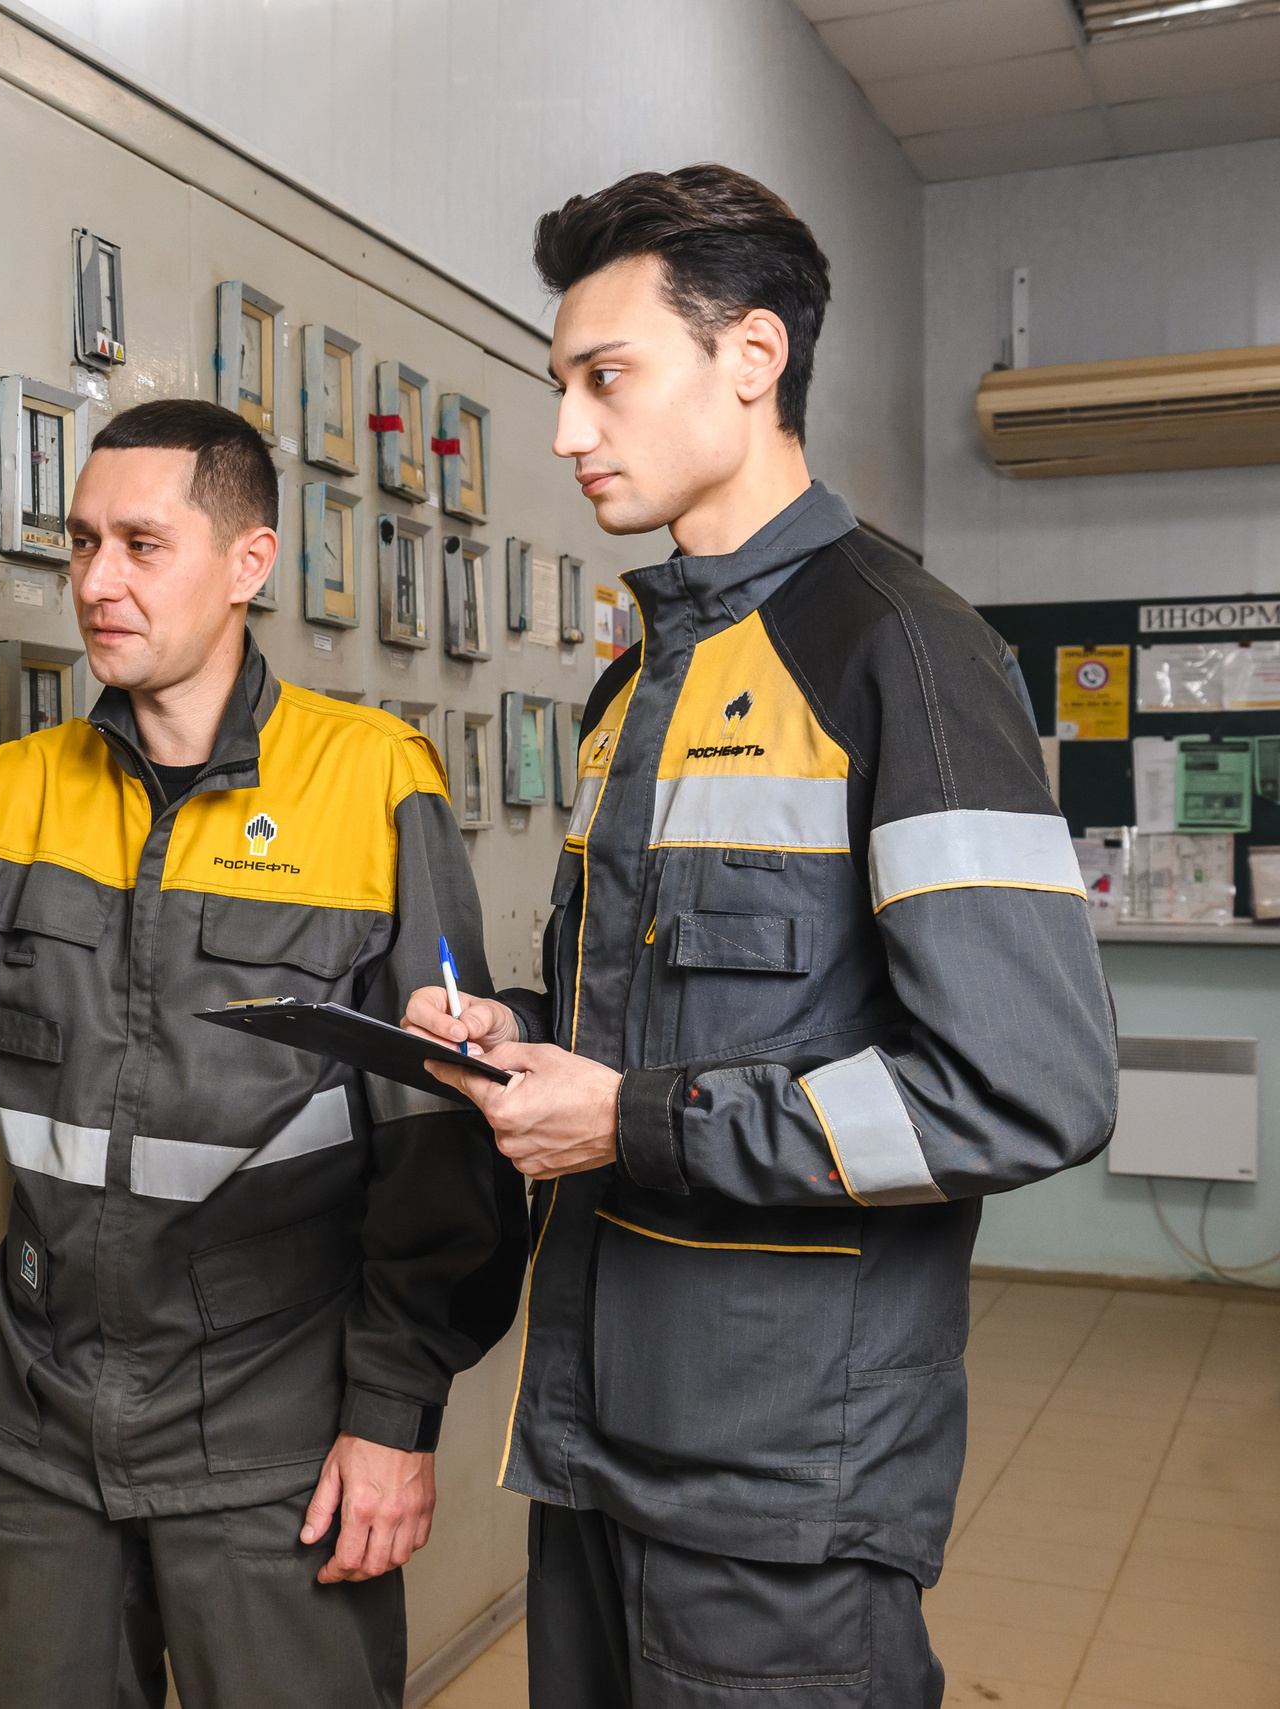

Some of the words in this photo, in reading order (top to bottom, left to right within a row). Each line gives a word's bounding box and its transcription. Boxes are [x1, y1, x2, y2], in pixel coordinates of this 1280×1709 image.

[1145, 603, 1280, 629] ИНФОРМ
[686, 744, 765, 760] РОСНЕФТЬ
[213, 856, 301, 874] РОСНЕФТЬ
